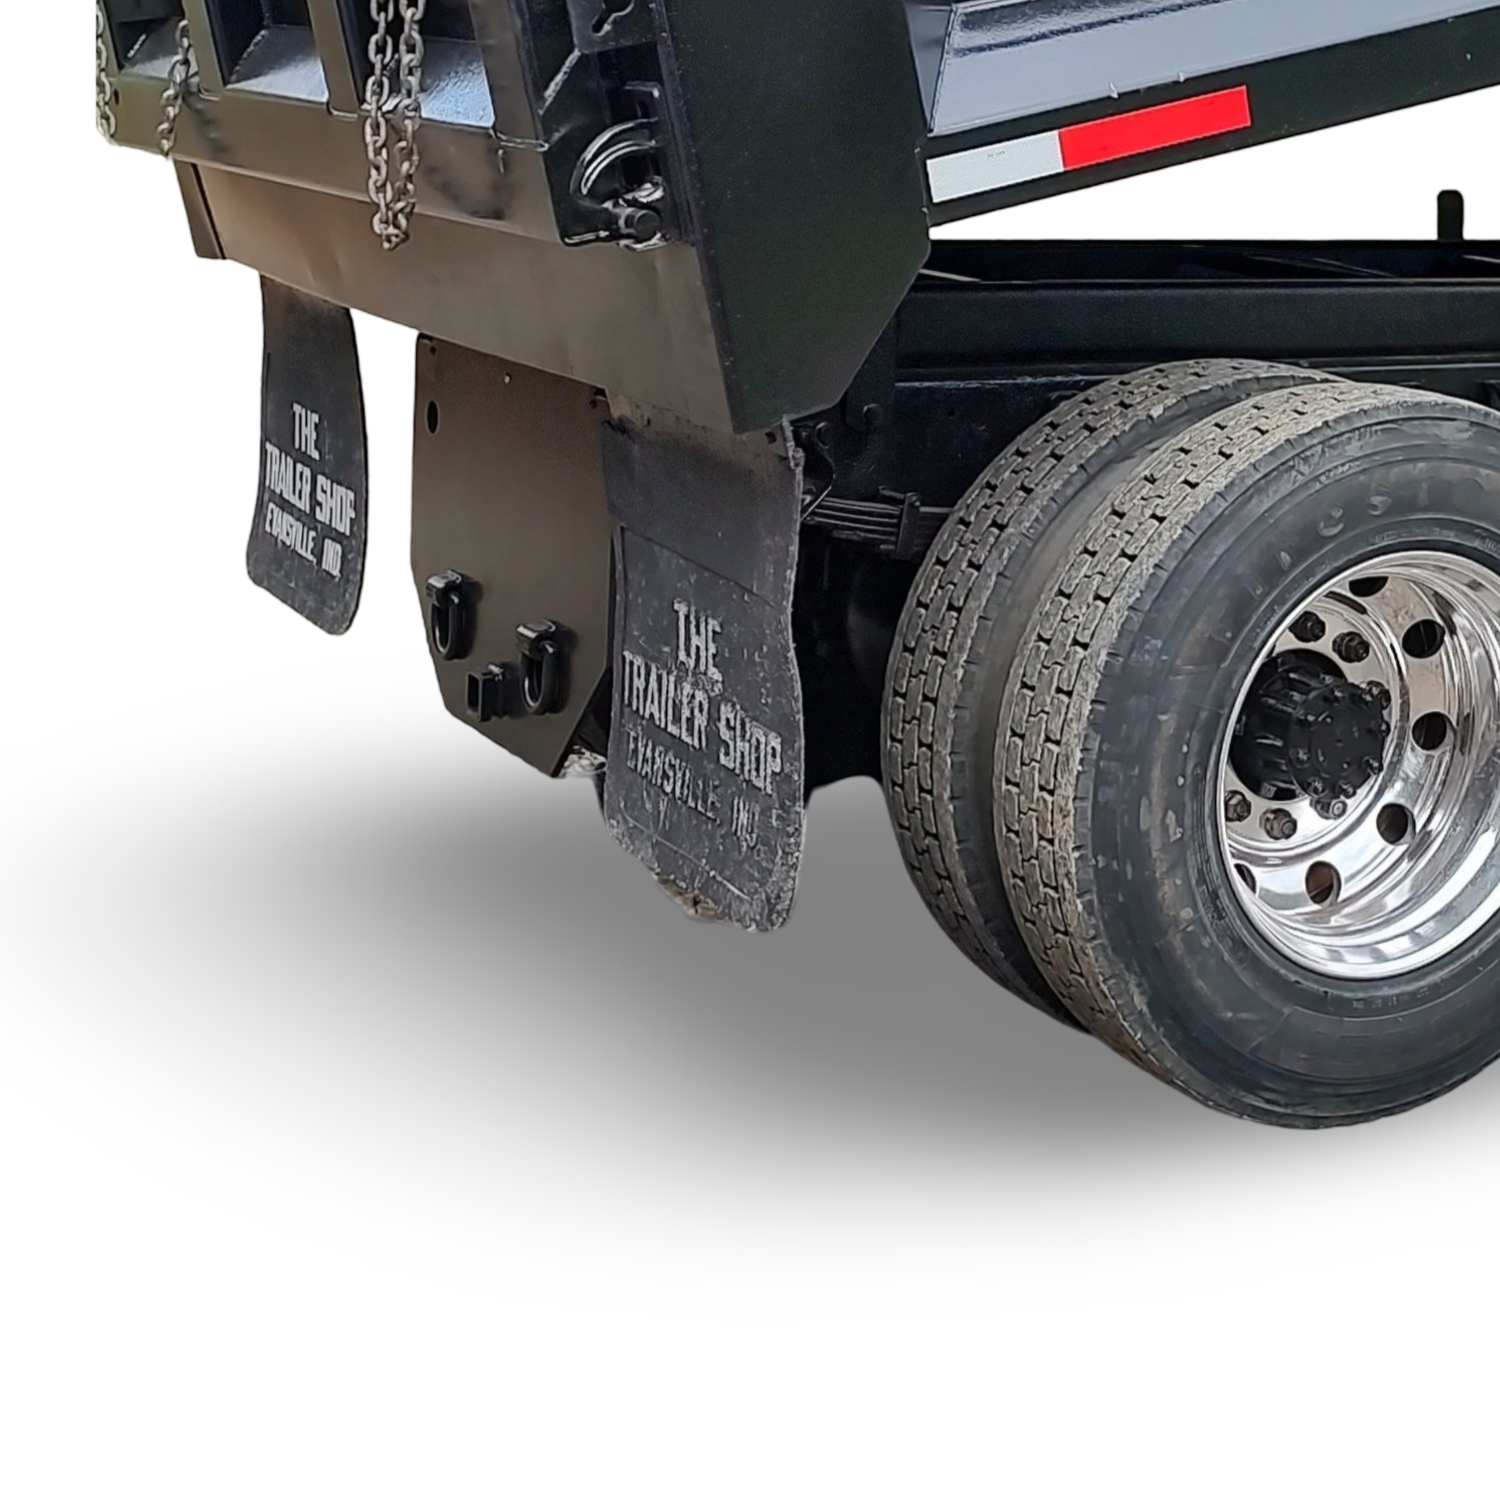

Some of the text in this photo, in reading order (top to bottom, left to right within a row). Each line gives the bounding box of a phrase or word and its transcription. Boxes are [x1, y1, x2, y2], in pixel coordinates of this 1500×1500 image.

[292, 402, 320, 461] THE
[264, 440, 357, 537] TRAILER SHOP
[672, 597, 724, 696] THE
[622, 649, 783, 797] TRAILER SHOP
